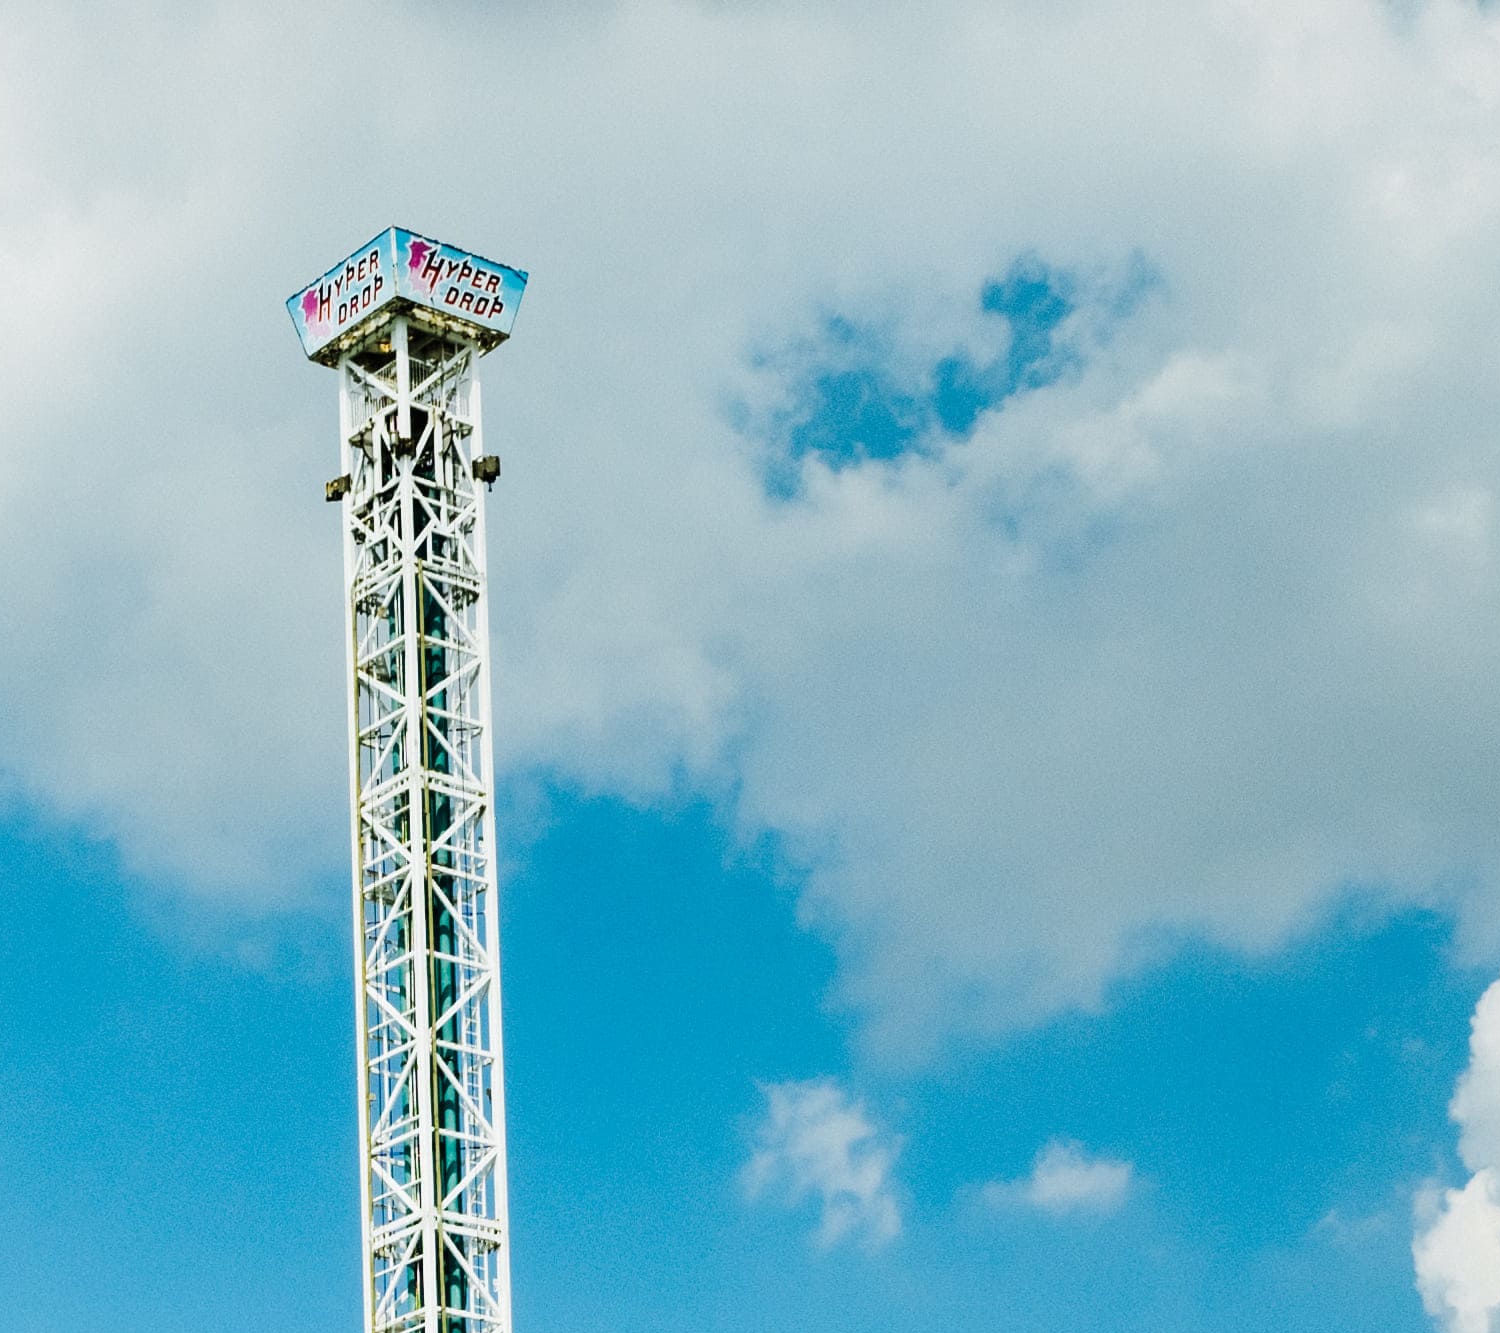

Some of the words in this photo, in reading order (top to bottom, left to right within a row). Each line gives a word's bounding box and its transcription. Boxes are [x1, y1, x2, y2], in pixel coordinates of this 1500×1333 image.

[317, 248, 380, 322] HYPER
[421, 247, 501, 294] HYPER
[338, 274, 384, 325] DROP
[444, 286, 504, 319] DROP
